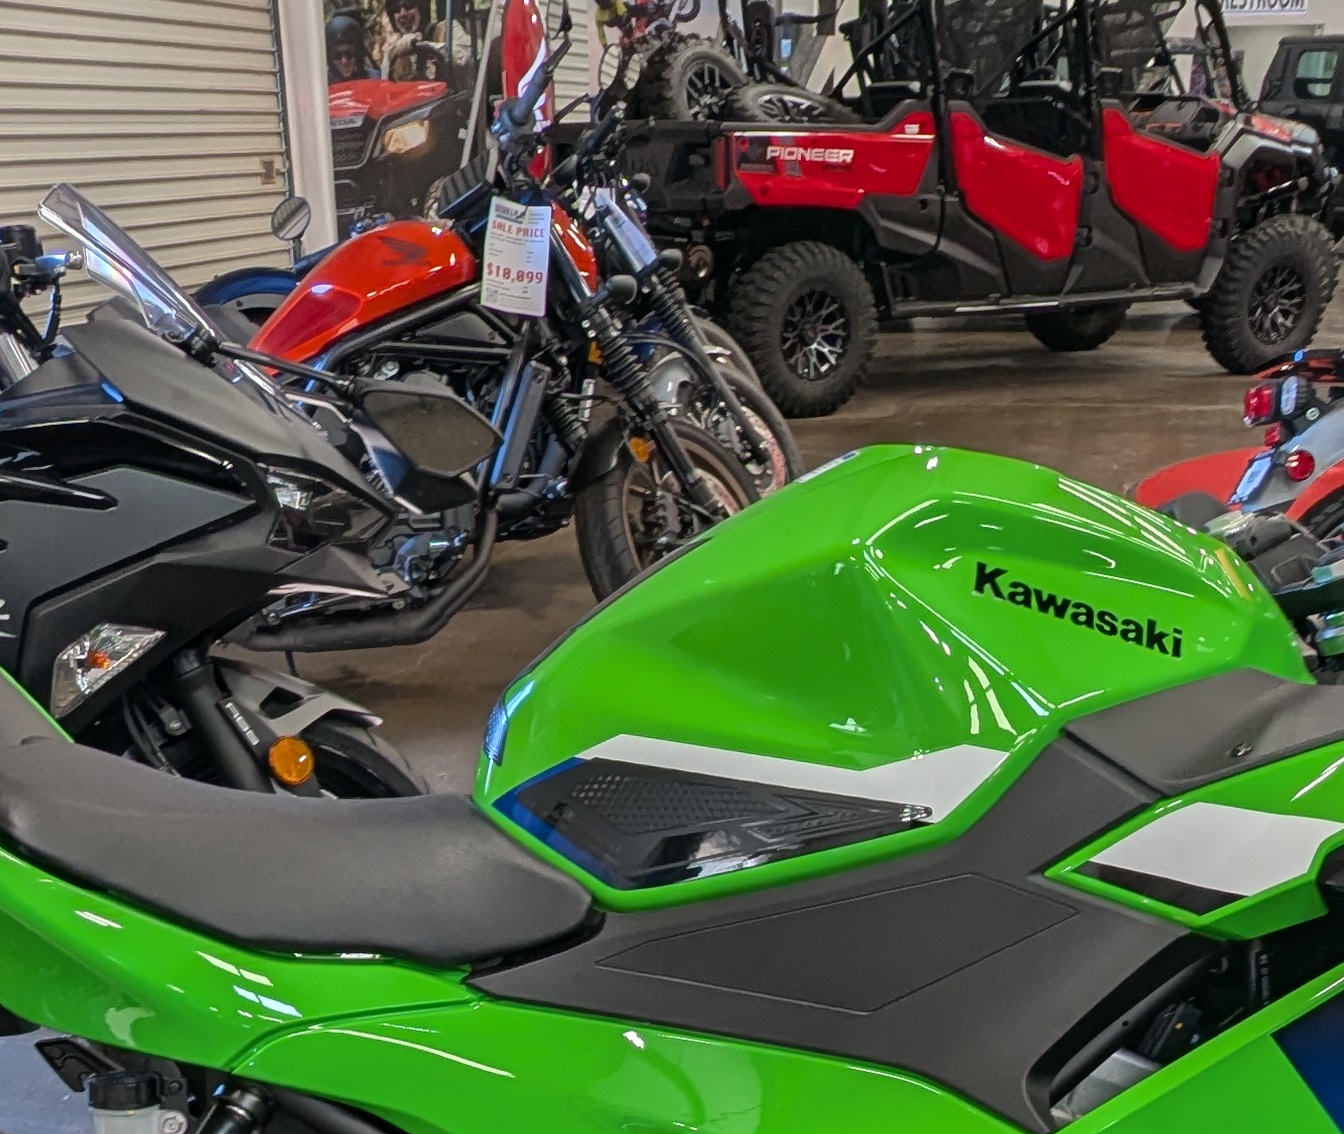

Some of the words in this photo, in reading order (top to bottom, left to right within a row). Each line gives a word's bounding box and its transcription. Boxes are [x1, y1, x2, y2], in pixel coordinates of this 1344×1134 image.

[766, 146, 854, 163] PIONEER
[492, 219, 513, 234] SALE
[517, 226, 545, 238] PRICE
[487, 262, 543, 284] $10,099
[973, 561, 1184, 659] Kawasaki
